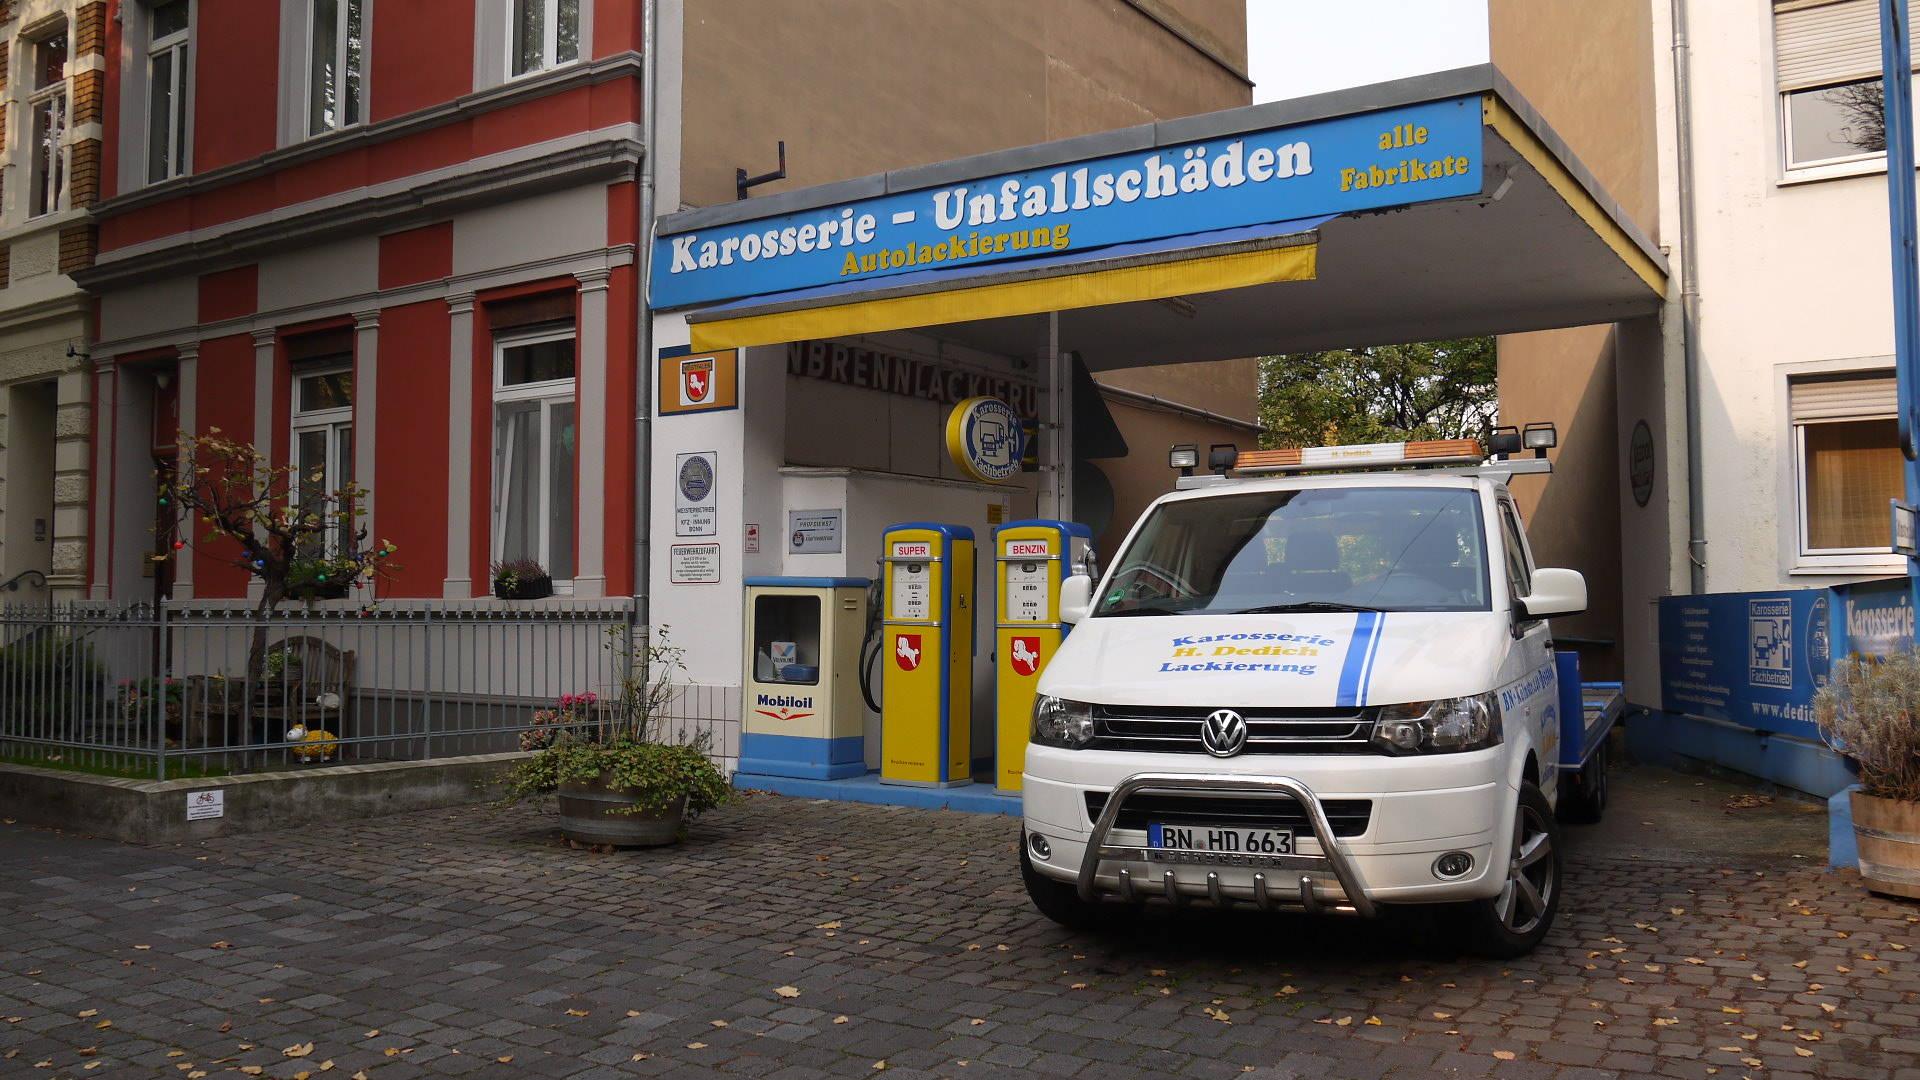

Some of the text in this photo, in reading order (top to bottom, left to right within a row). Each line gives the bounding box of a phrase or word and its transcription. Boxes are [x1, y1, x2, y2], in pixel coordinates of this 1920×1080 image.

[1379, 123, 1429, 150] alle
[1340, 155, 1469, 192] Fabrikate
[671, 208, 876, 274] Karosserie
[933, 139, 1313, 230] Unfallschäden
[840, 223, 1071, 277] Autolackierung
[974, 403, 1018, 426] Karosserie
[976, 455, 1019, 477] Fachbetrieb
[898, 547, 926, 555] SUPER
[1012, 545, 1046, 555] BENZIN
[1751, 602, 1789, 615] Karosserie
[1846, 595, 1914, 637] Karosserie
[1172, 631, 1335, 647] Karosserie
[1172, 645, 1320, 657] H. Dedich
[1158, 661, 1317, 675] Lackierung
[1751, 670, 1790, 685] Fachbetrieb
[757, 694, 813, 708] Mobiloil
[1752, 702, 1817, 723] www.dedic
[1163, 828, 1192, 850] BN
[1208, 830, 1239, 851] HD
[1246, 832, 1291, 853] 663
